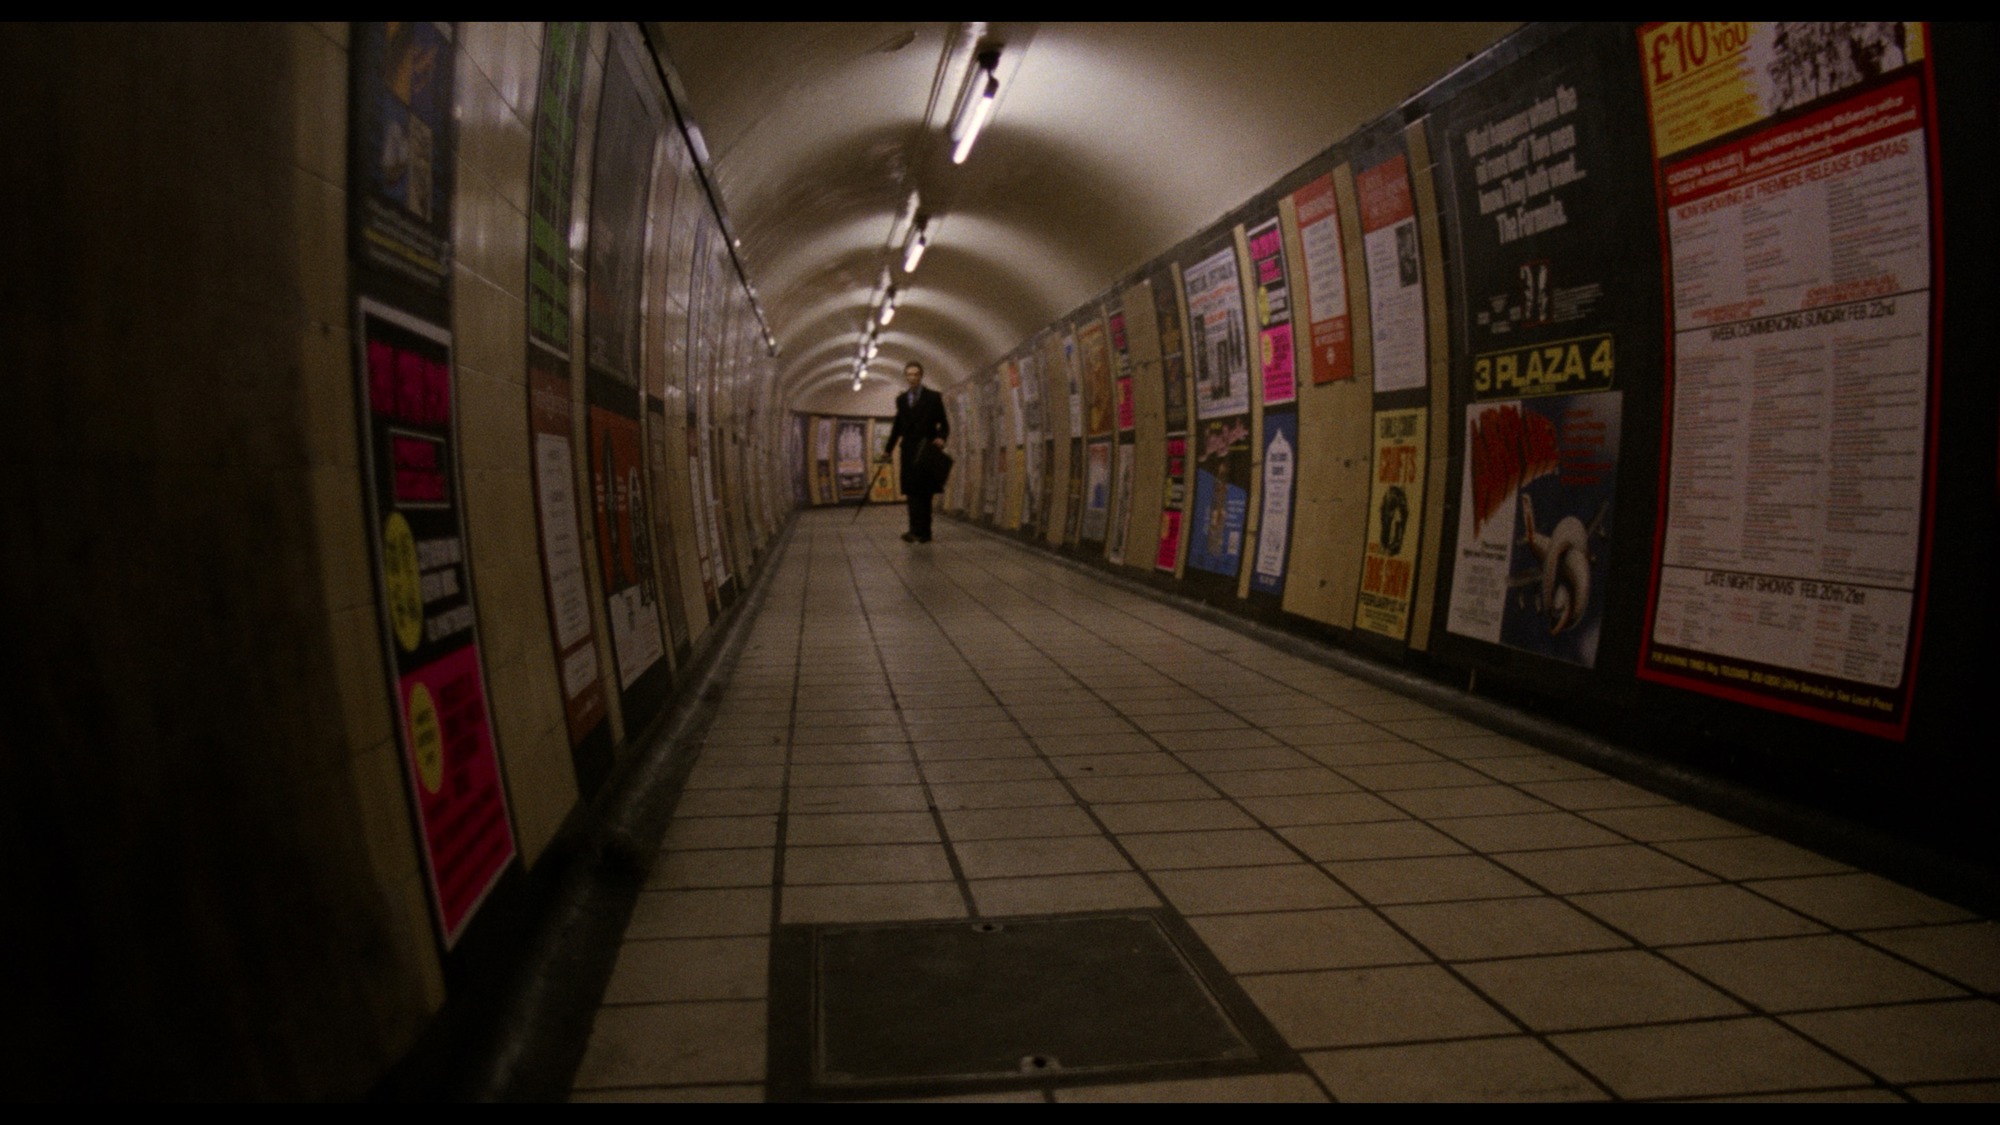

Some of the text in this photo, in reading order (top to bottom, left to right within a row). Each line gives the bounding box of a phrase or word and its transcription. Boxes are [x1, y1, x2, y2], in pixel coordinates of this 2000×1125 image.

[1651, 22, 1708, 85] £10
[1677, 205, 1699, 219] NOW
[1699, 191, 1743, 214] SHOWING
[1756, 174, 1804, 196] PREMIERE
[1805, 158, 1852, 181] RELEASE
[1853, 138, 1909, 168] CINEMAS
[1710, 323, 1739, 341] WEEK
[1739, 314, 1805, 337] COMMENCING
[1805, 308, 1845, 329] SUNDAY
[1871, 300, 1896, 319] 22nd
[1474, 339, 1615, 391] 3 PLAZA 4
[1704, 572, 1727, 586] LATE
[1727, 574, 1754, 590] NIGHT
[1756, 579, 1794, 594] SHOWS
